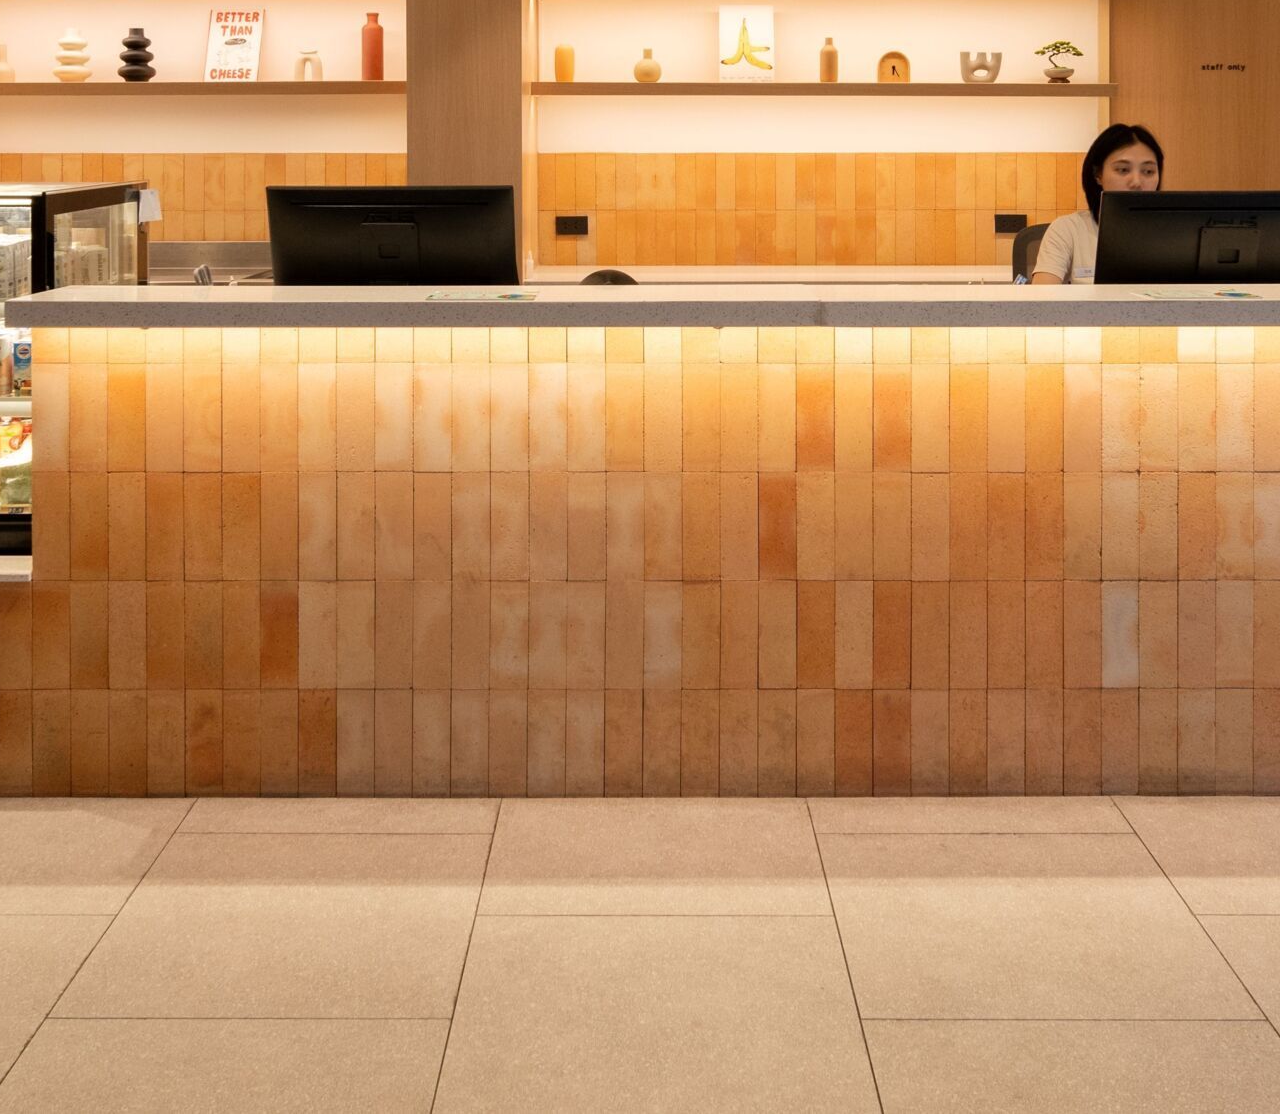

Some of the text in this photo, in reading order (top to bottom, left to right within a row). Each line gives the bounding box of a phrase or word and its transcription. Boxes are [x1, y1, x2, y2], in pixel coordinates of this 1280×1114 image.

[216, 11, 260, 23] BETTER
[220, 25, 253, 36] THAN
[1227, 64, 1246, 72] only
[209, 68, 252, 80] CHEESE
